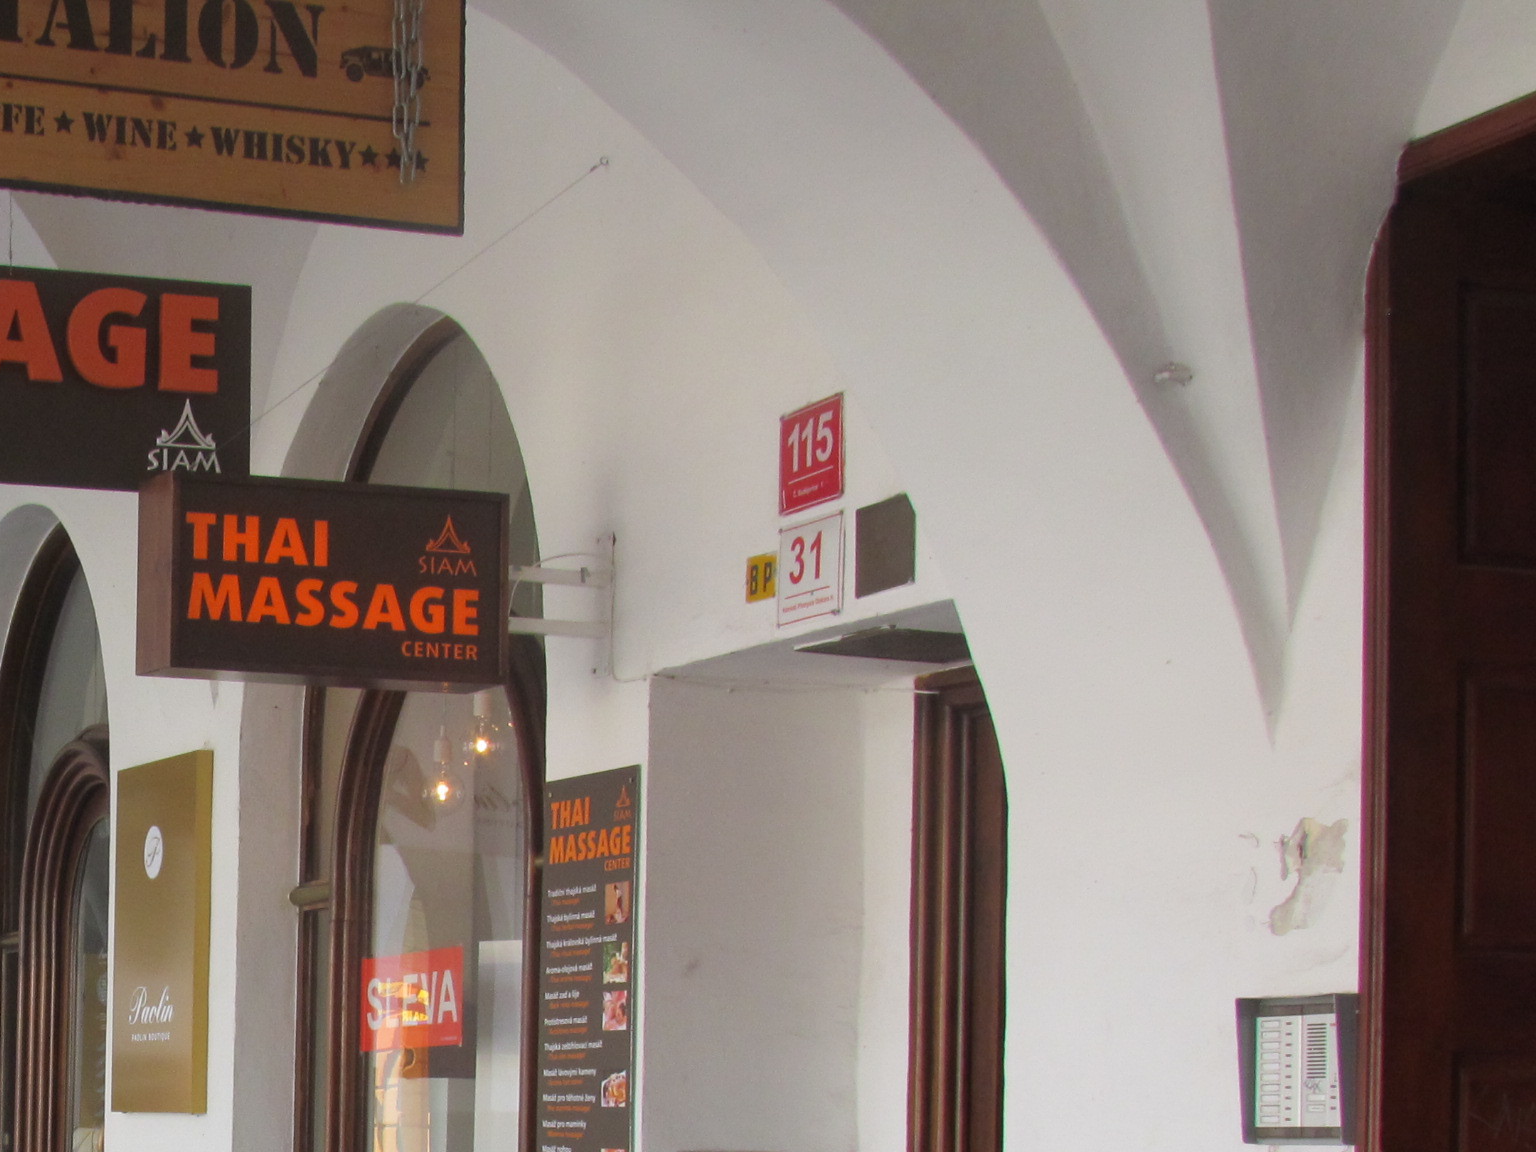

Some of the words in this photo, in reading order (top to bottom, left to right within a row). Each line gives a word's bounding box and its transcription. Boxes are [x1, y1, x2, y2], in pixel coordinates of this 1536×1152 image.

[82, 111, 178, 152] WINE
[210, 126, 358, 170] WHISKY
[146, 447, 222, 474] SIAM
[787, 410, 834, 473] 115
[185, 511, 330, 568] THAI
[789, 530, 823, 585] 31
[417, 552, 478, 577] SIAM
[185, 572, 480, 637] MASSAGE
[400, 639, 479, 662] CENTER
[550, 796, 591, 830] THAI
[549, 824, 632, 865] MASSAGE
[604, 857, 631, 872] CENTER
[367, 969, 458, 1031] SLEVA
